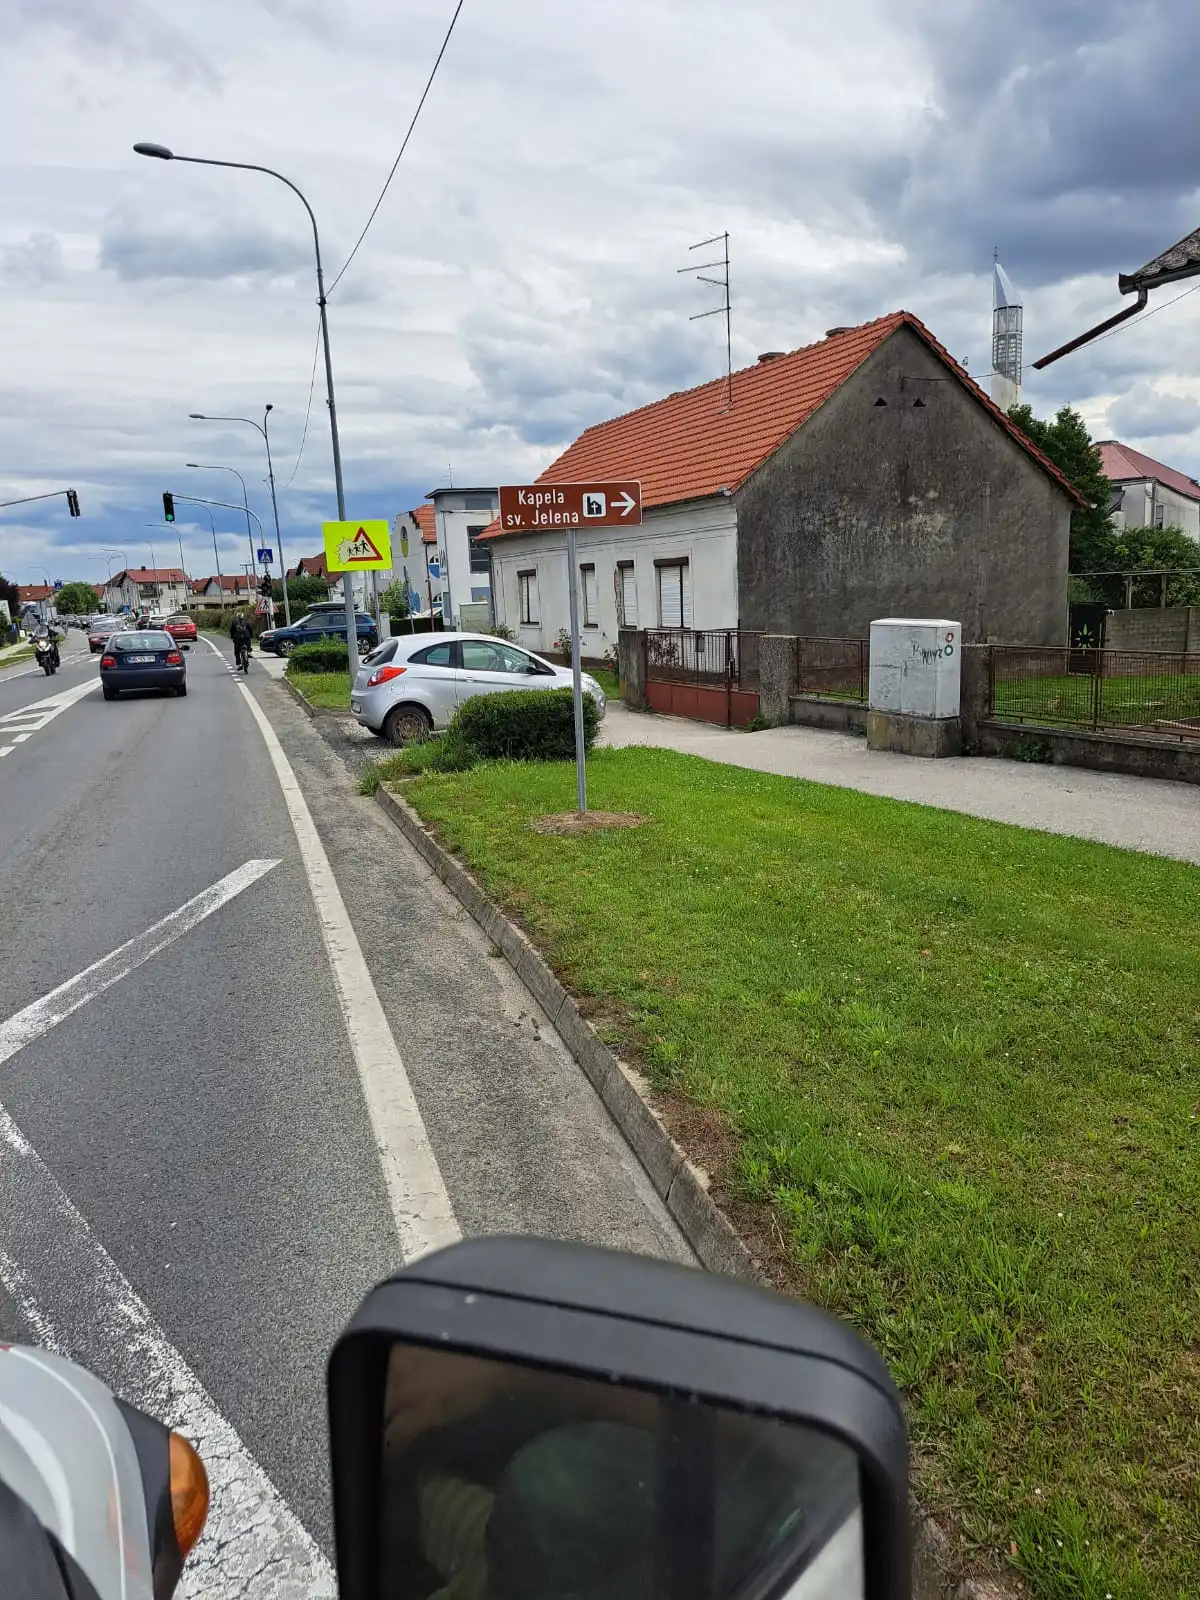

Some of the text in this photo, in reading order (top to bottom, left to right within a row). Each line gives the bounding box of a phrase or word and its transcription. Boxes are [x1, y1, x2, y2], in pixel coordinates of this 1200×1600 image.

[518, 489, 564, 508] Kapela
[507, 510, 579, 525] sv. Jelena
